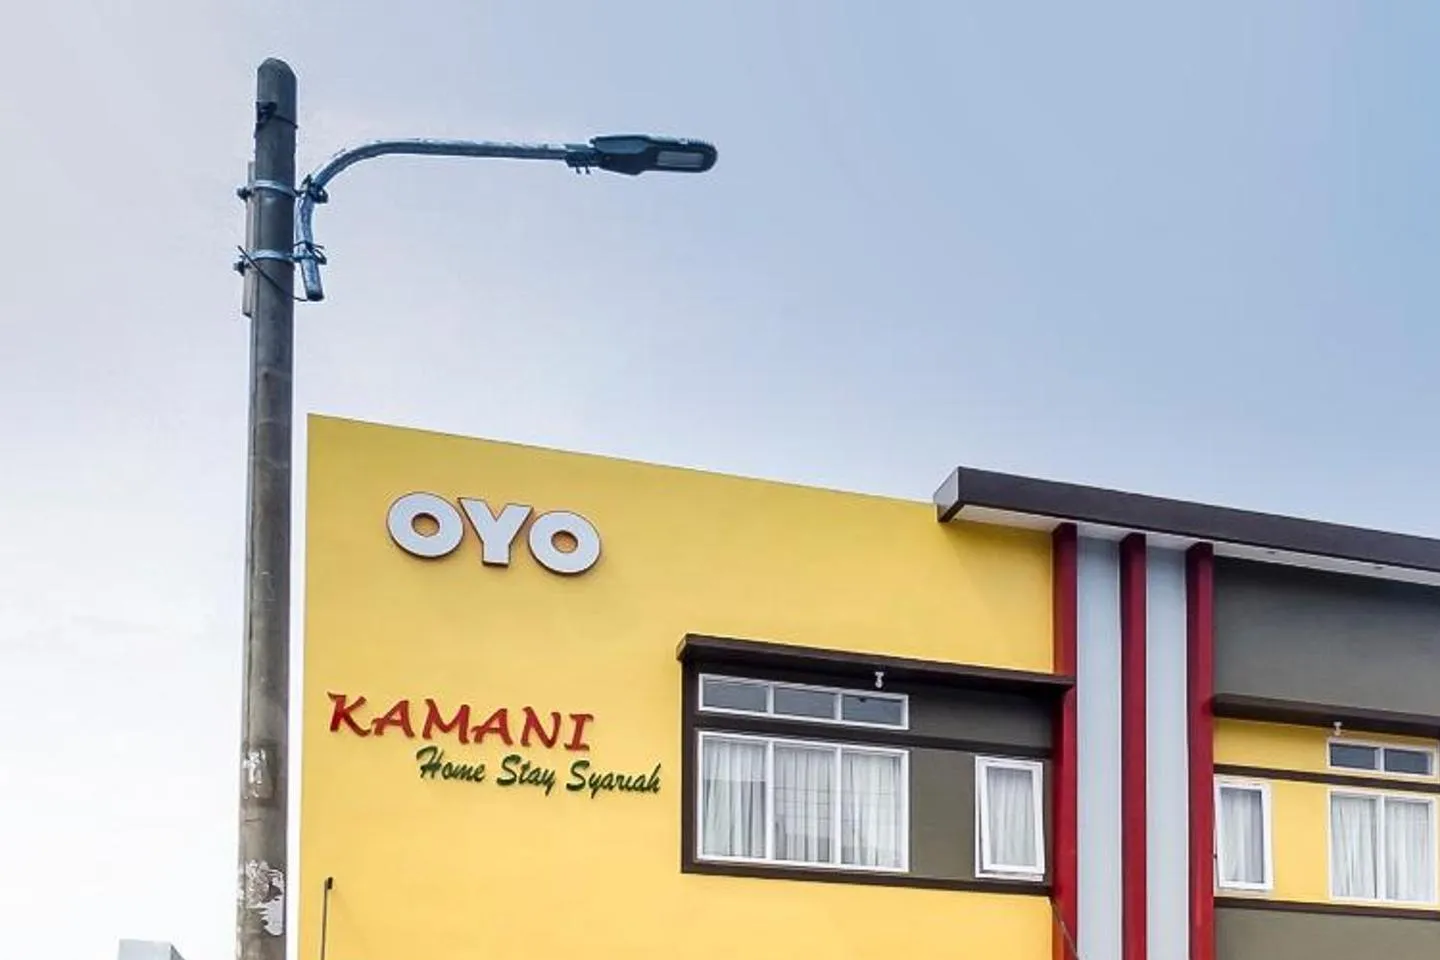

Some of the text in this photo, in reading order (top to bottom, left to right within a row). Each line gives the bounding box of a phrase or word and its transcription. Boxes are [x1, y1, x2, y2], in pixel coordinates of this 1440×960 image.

[386, 491, 602, 577] OYO
[327, 691, 595, 752] KAMANI
[416, 745, 662, 798] Home Stay Syariah
